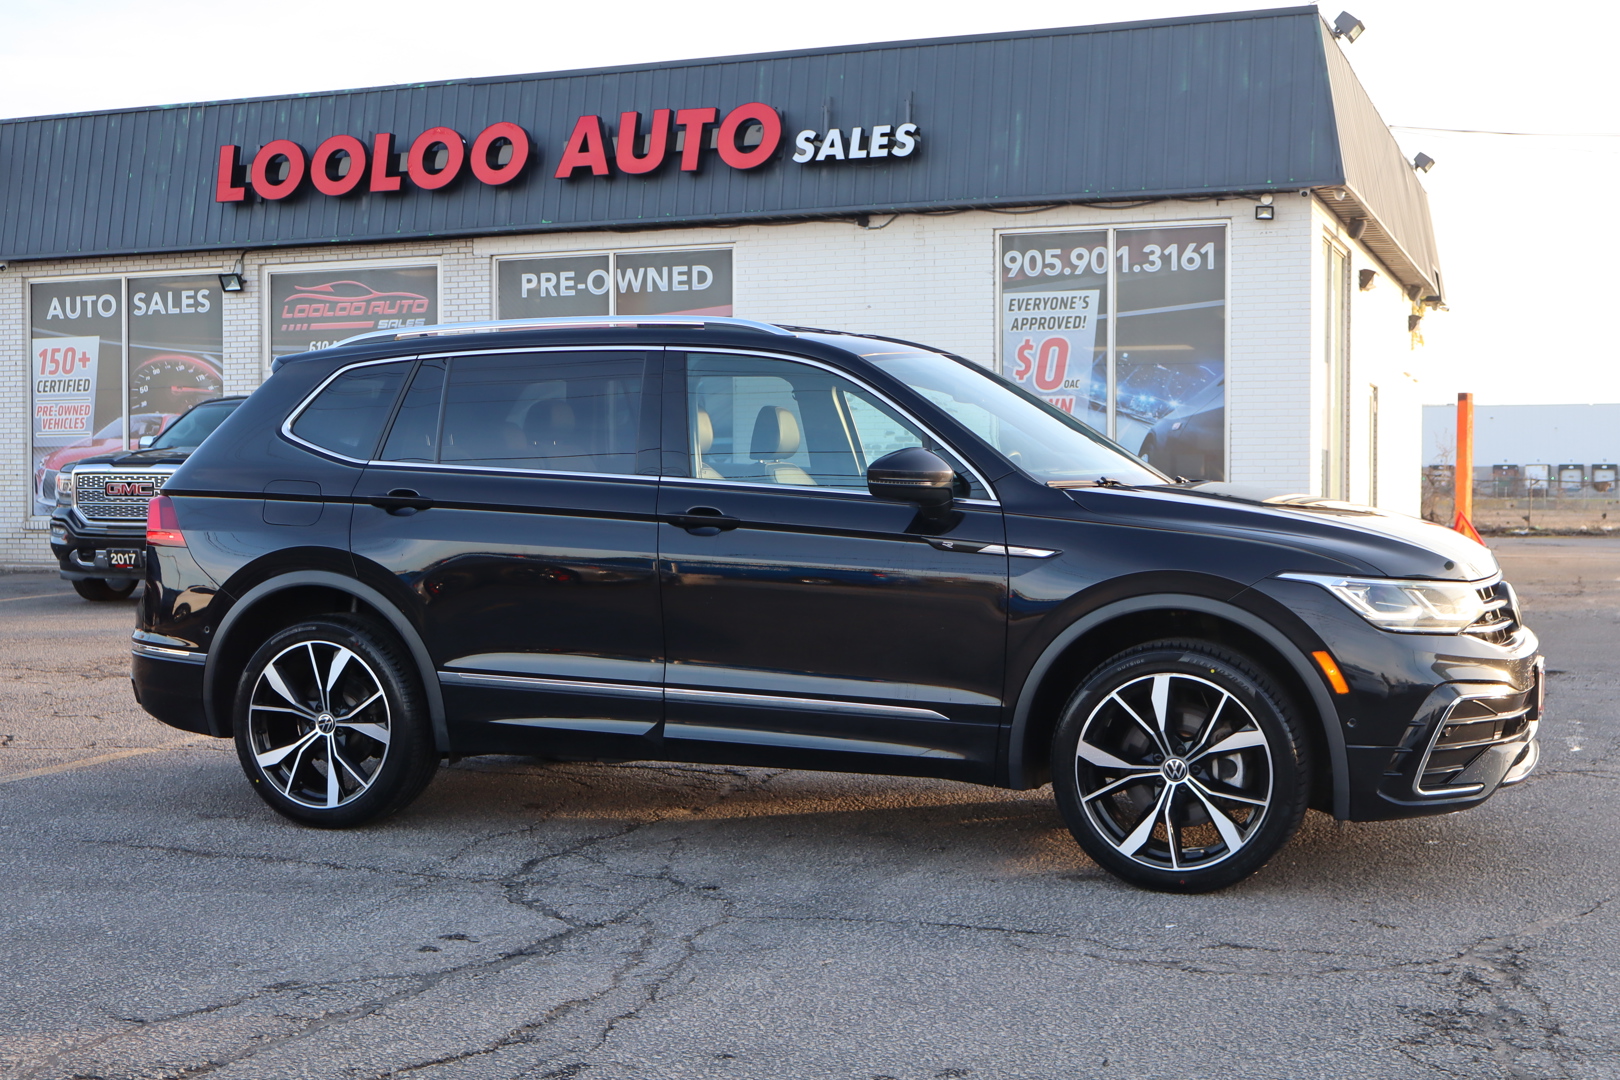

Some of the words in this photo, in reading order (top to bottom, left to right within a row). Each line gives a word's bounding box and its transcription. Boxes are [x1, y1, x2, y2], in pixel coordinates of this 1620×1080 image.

[215, 121, 531, 203] LOOLOO
[553, 102, 782, 179] AUTO
[791, 122, 919, 164] SALES
[1003, 241, 1215, 278] 905.901.3161
[521, 264, 714, 298] PRE-OWNED
[46, 293, 117, 320] AUTO
[133, 288, 211, 316] SALES
[281, 301, 367, 318] LOOLOO
[367, 299, 429, 315] AUTO
[1008, 295, 1090, 312] EVERYONE'S
[377, 318, 426, 329] SALES
[1009, 315, 1087, 332] APPROVED!
[38, 346, 91, 376] 150+
[1013, 336, 1070, 391] $0
[1063, 379, 1080, 389] OAC
[36, 378, 91, 393] CERTIFIED
[36, 404, 91, 417] PRE-OWNED
[42, 417, 86, 430] VEHICLES
[106, 482, 153, 495] GMC
[110, 553, 136, 565] 2017
